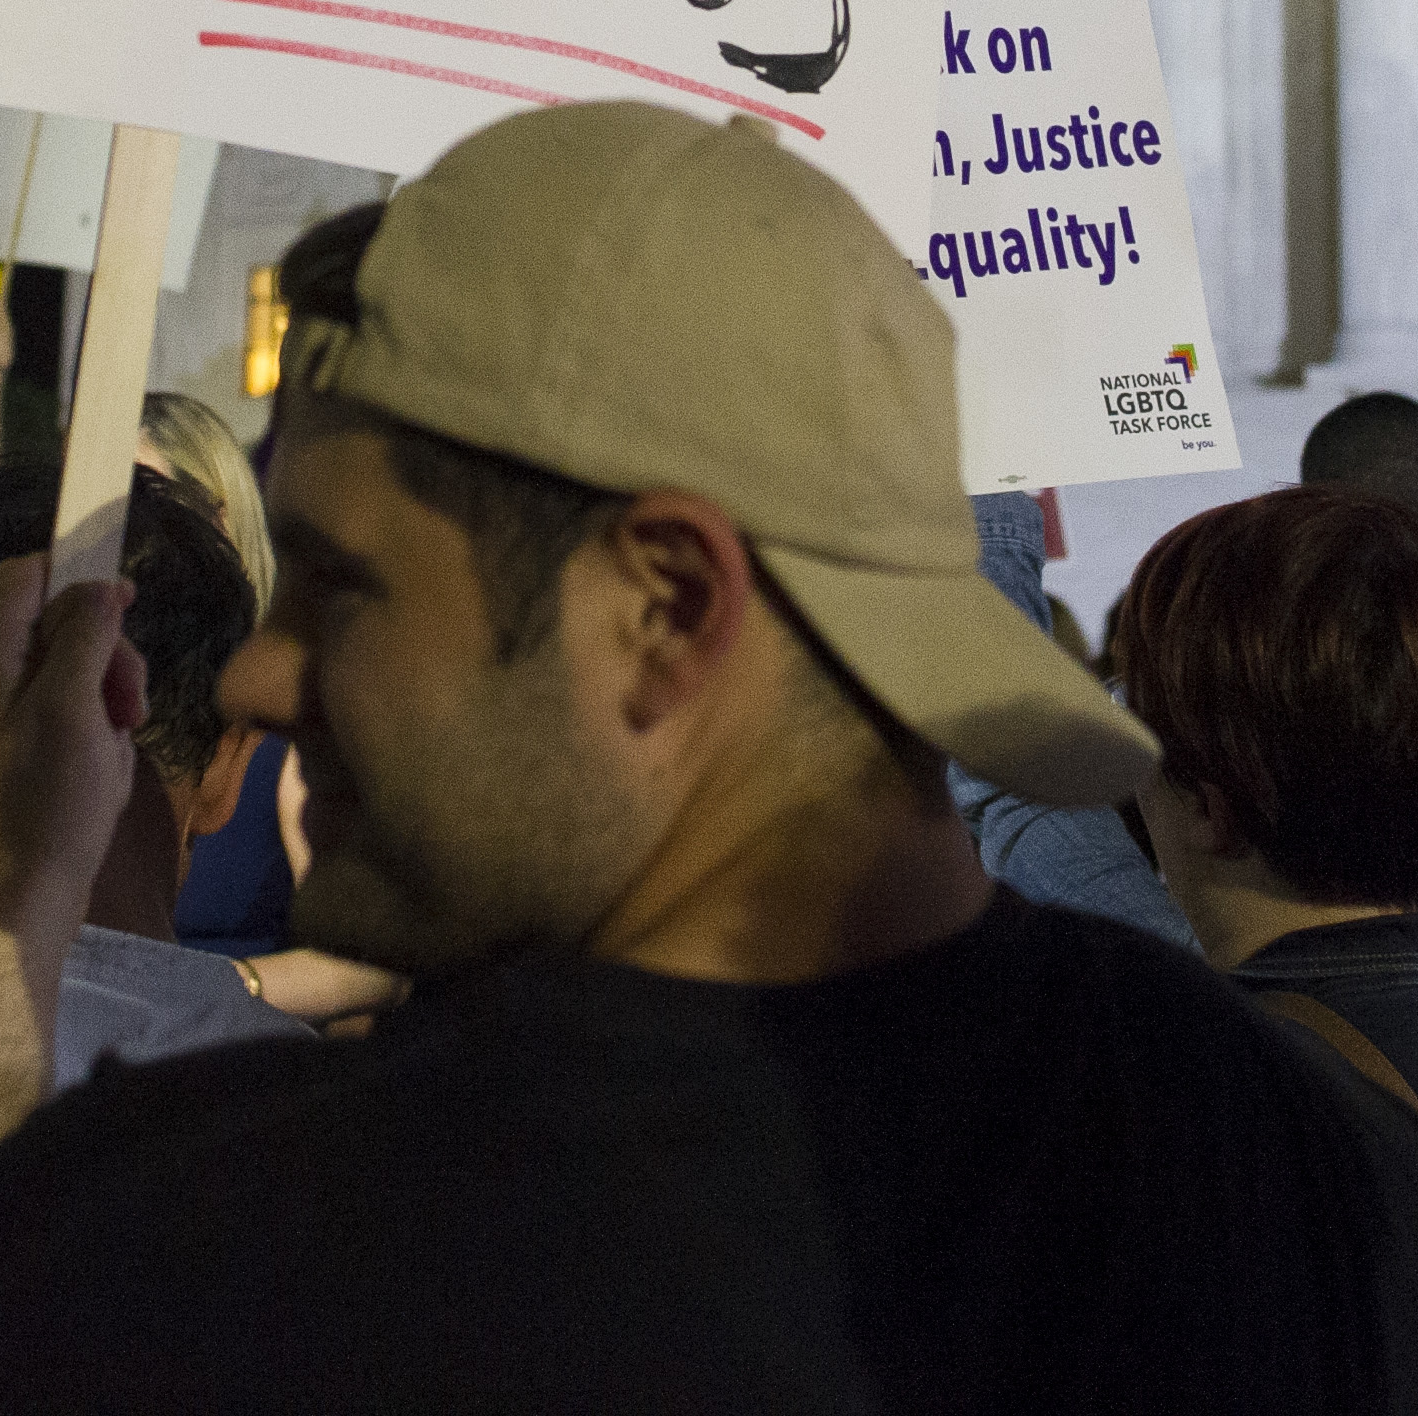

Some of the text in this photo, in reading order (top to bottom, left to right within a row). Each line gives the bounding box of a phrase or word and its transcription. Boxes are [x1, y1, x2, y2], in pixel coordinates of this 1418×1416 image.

[941, 10, 1053, 75] k on
[983, 104, 1163, 176] Justice
[906, 205, 1141, 299] quality!
[1099, 371, 1183, 391] NATIONAL
[1103, 388, 1189, 417] LGBTQ
[1109, 412, 1213, 436] TASK FORCE
